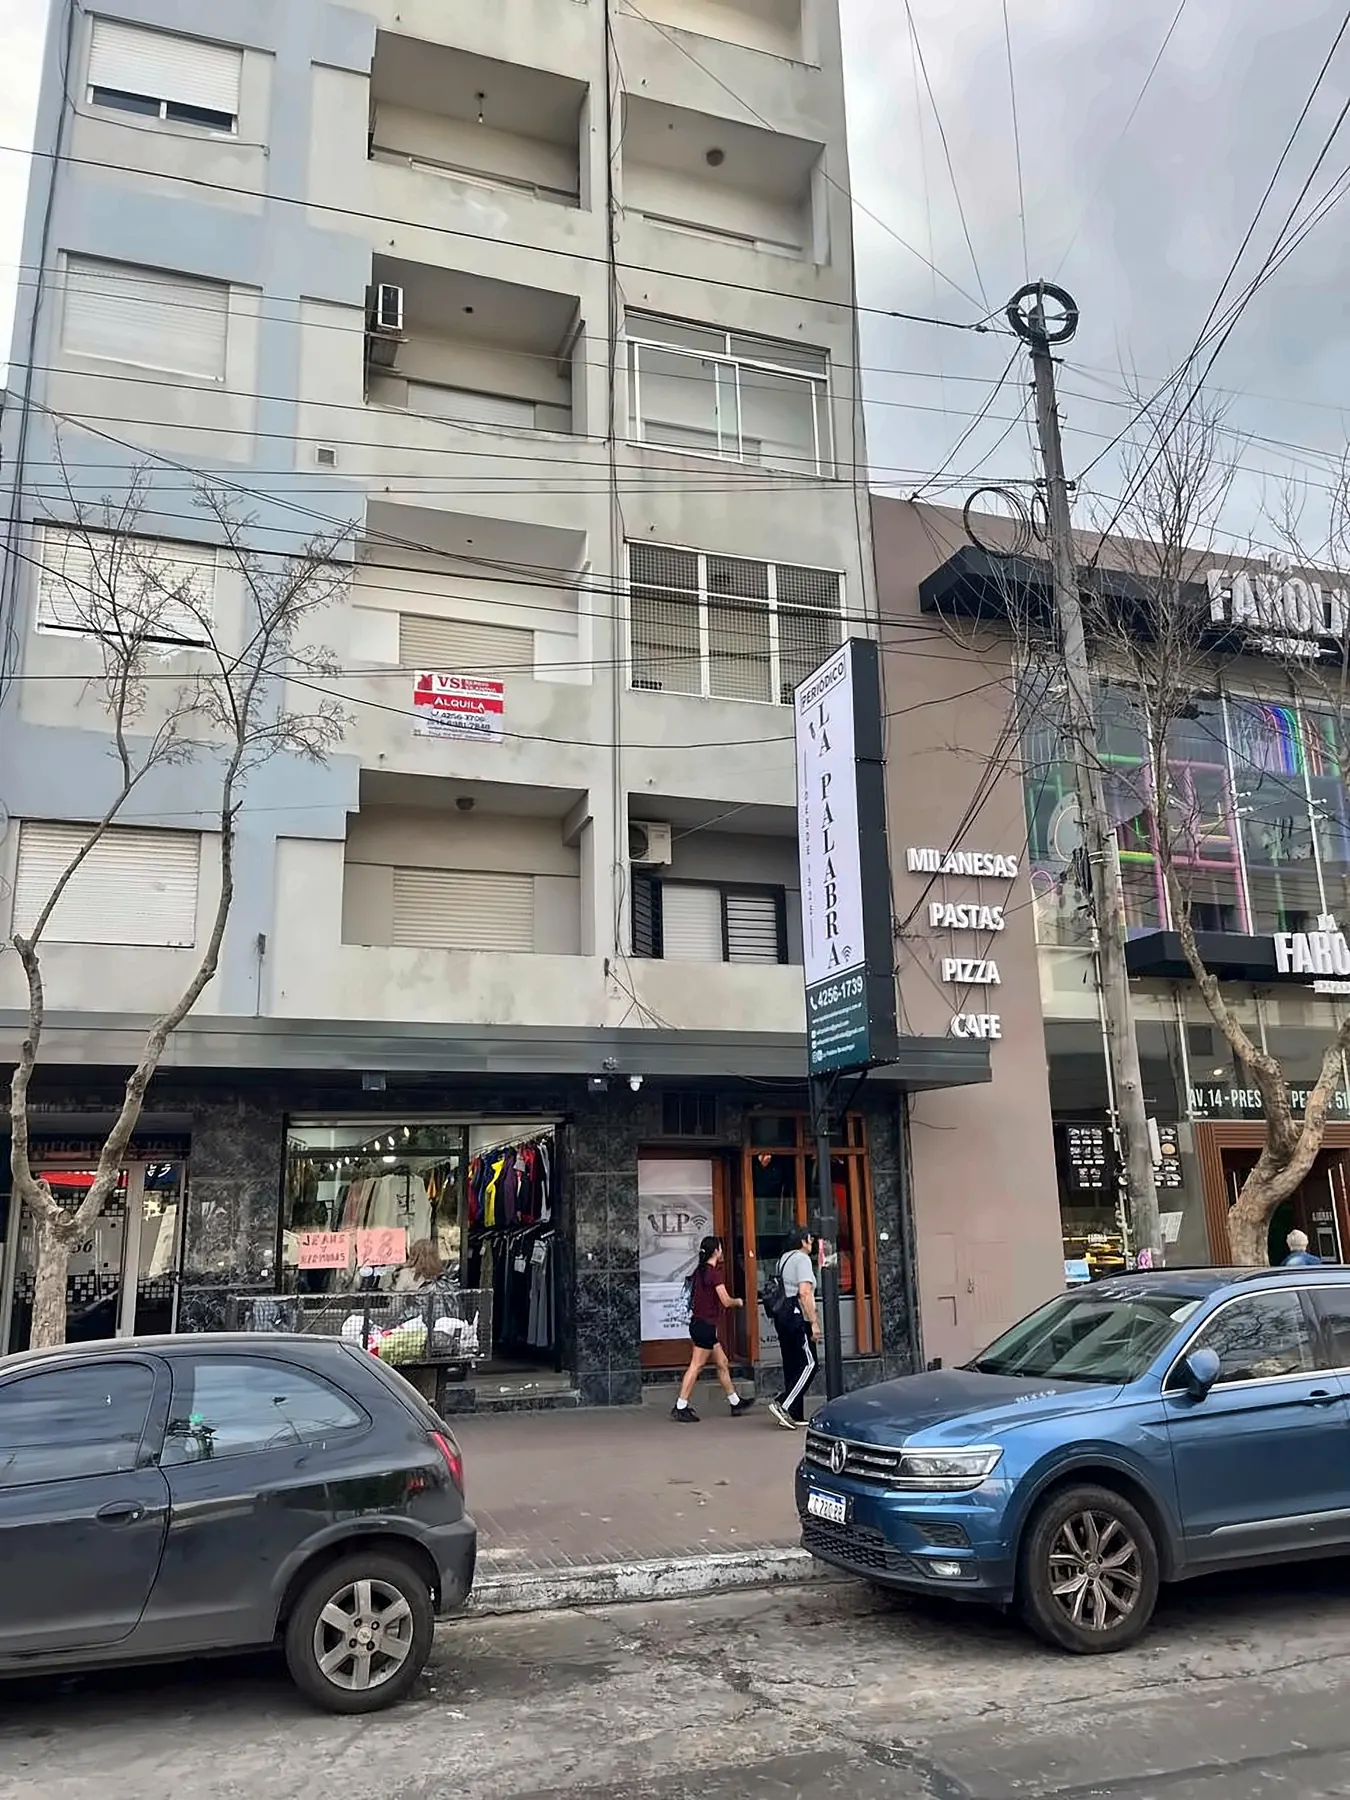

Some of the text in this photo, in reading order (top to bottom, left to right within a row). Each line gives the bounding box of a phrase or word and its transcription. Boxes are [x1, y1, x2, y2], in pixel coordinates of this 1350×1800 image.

[434, 696, 485, 712] ALQUILA
[820, 772, 842, 970] PALABRA
[906, 847, 1018, 878] MILANESAS
[928, 902, 1005, 931] PASTAS
[941, 957, 1002, 985] PIZZA
[817, 975, 864, 1007] 4256-1739
[950, 1013, 1002, 1040] CAFE
